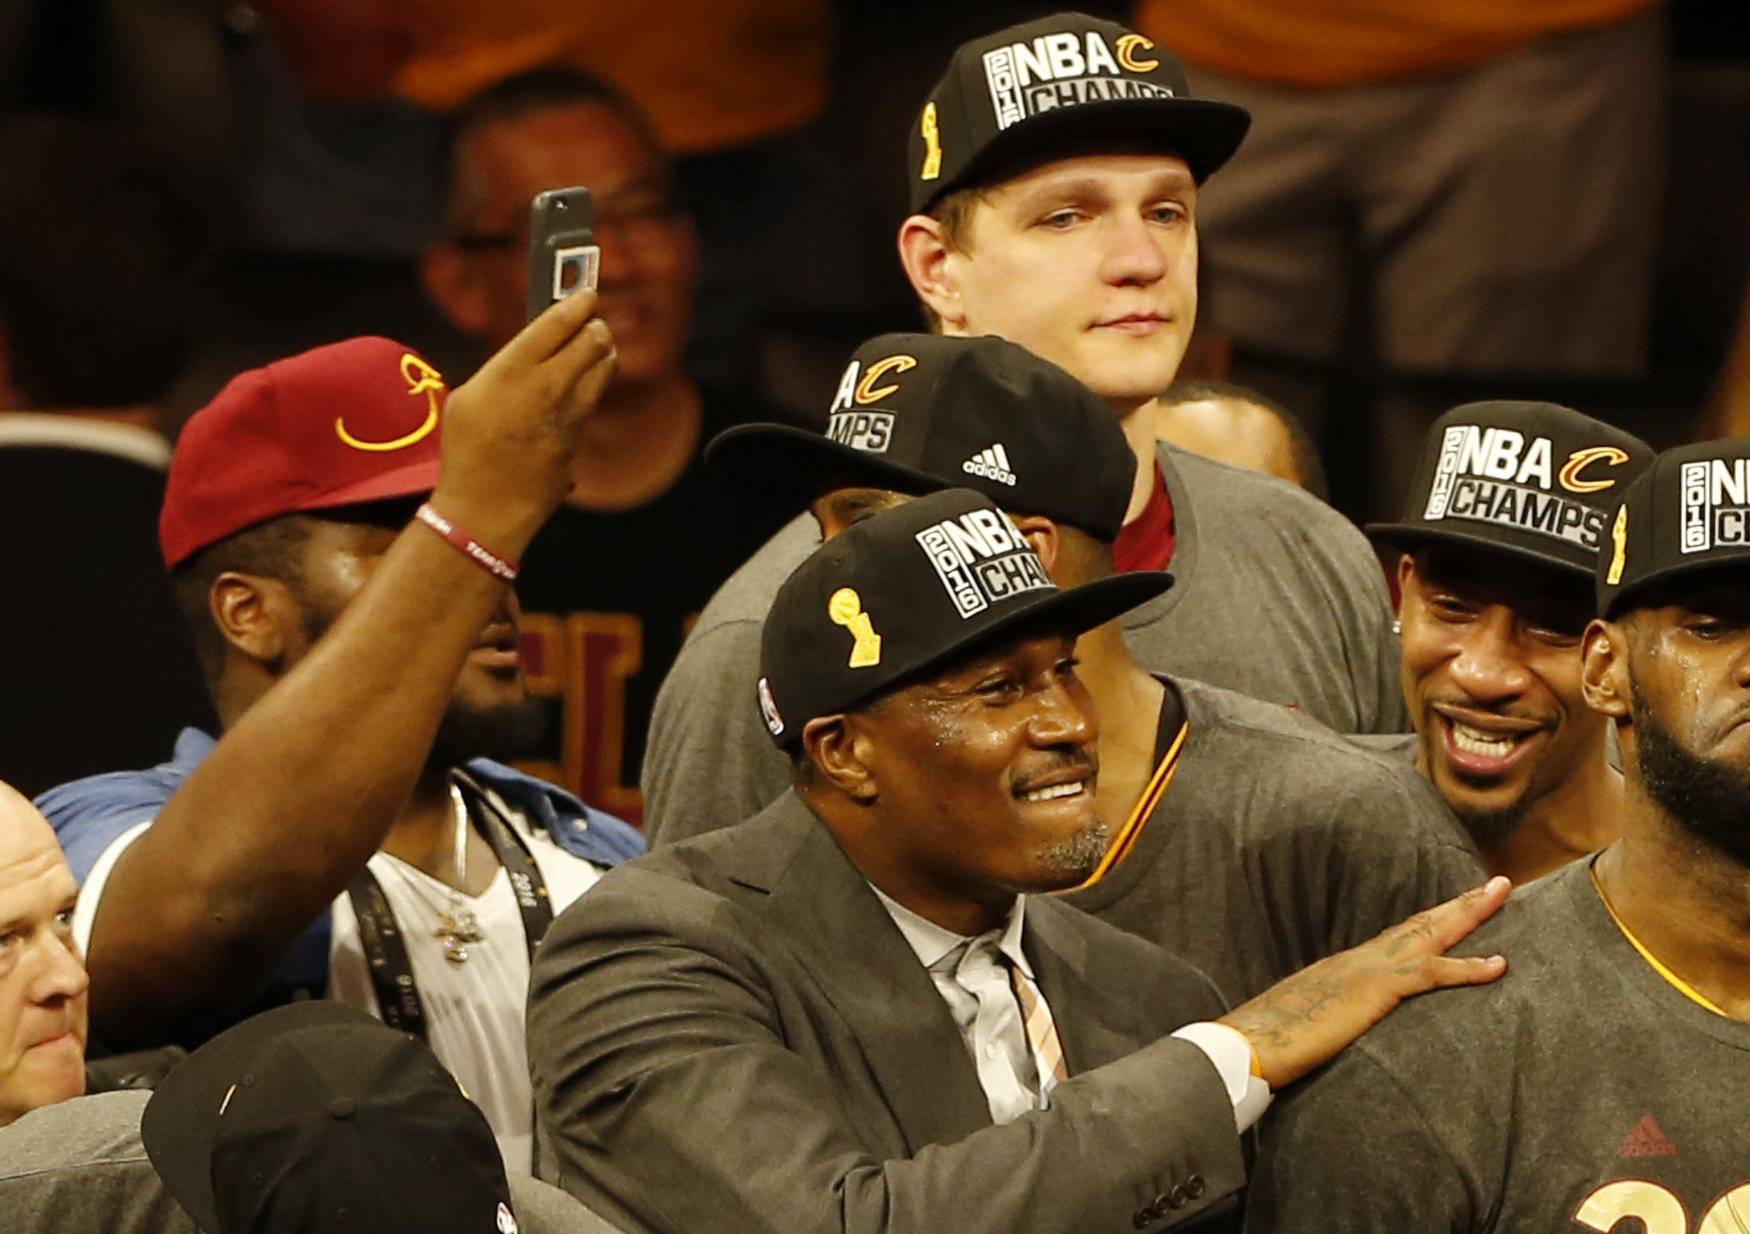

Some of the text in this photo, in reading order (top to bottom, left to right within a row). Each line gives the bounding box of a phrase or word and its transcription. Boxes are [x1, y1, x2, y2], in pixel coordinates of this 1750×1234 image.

[1012, 31, 1121, 87] NBA
[962, 460, 1017, 487] adidas
[1427, 428, 1467, 519] 2016
[1457, 425, 1552, 490] NBA
[1450, 480, 1606, 549] CHAMPS
[1683, 463, 1711, 552] 2016
[918, 527, 985, 615] 2016
